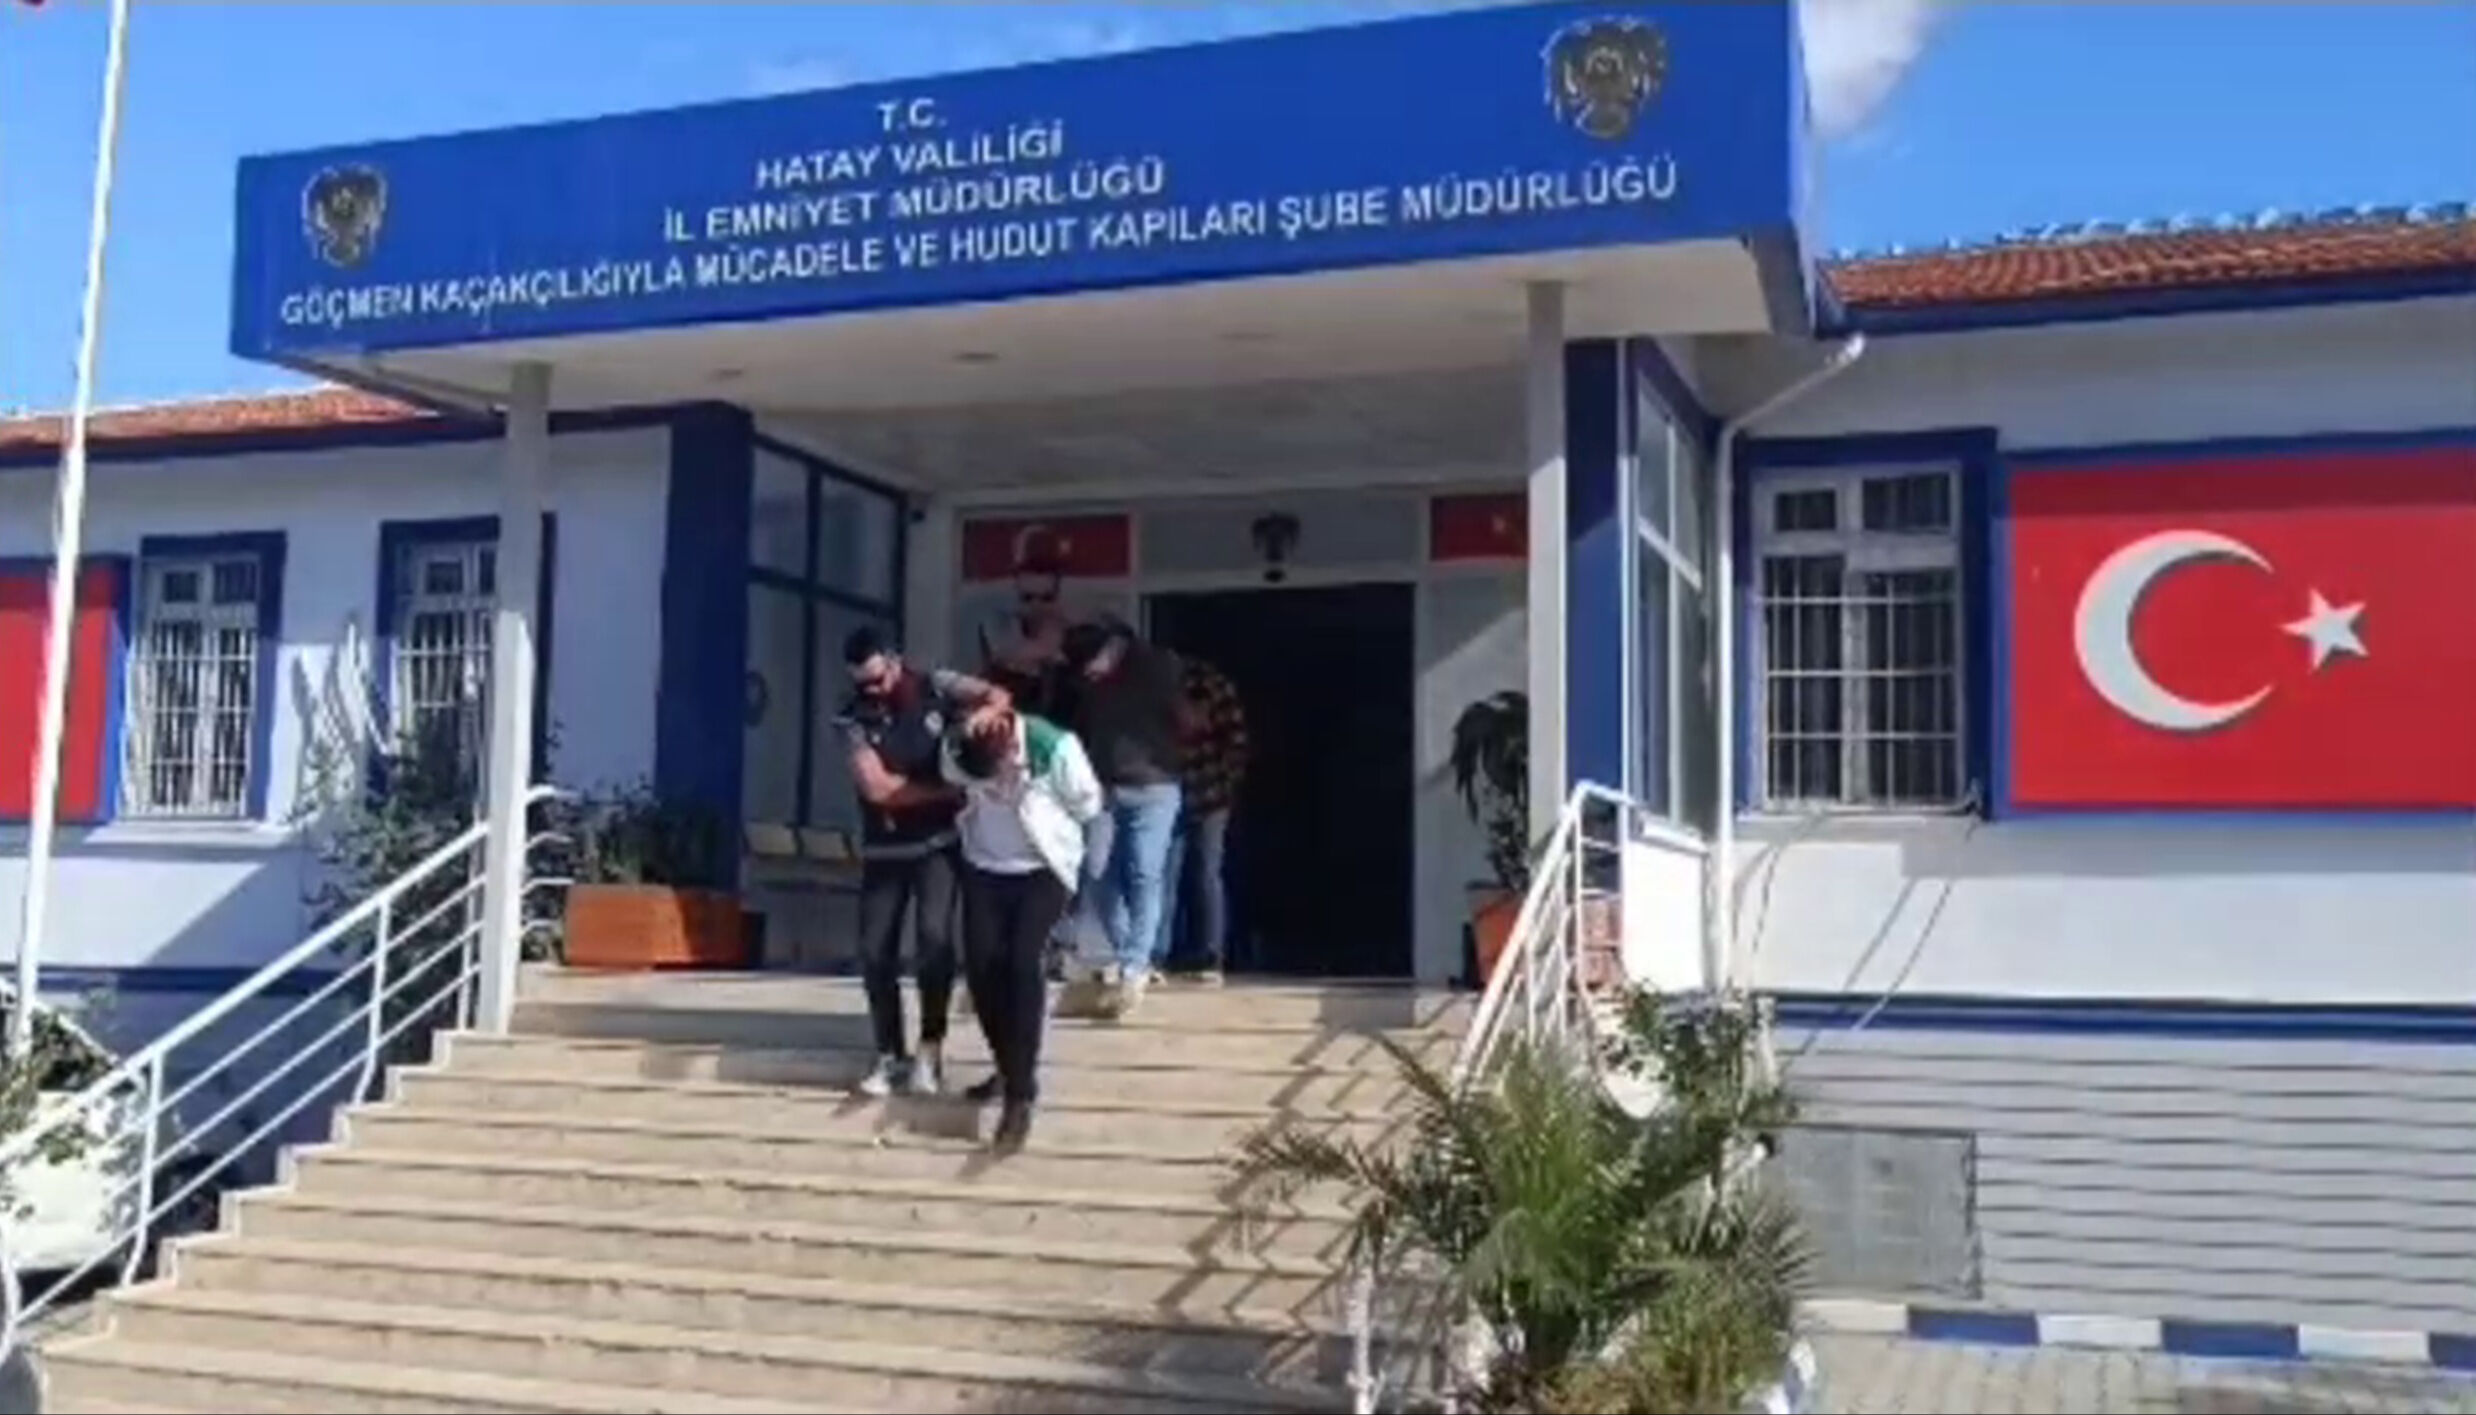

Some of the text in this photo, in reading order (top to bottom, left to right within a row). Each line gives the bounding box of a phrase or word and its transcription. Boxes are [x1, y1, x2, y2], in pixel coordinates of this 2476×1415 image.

[755, 117, 1064, 191] HATAY VALİLİĞİ
[877, 97, 948, 132] T.C.
[663, 155, 1164, 243] İL EMNİYET MÜDÜRLÜĞÜ
[280, 284, 413, 330] GÖÇMEN
[694, 240, 884, 287] MÜCADELE
[893, 230, 940, 268] VE
[951, 217, 1079, 263] HUDUT
[1089, 198, 1266, 251] KAPILARI
[1277, 186, 1390, 240] ŞUBE
[1401, 152, 1679, 223] MÜDÜRLÜĞÜ
